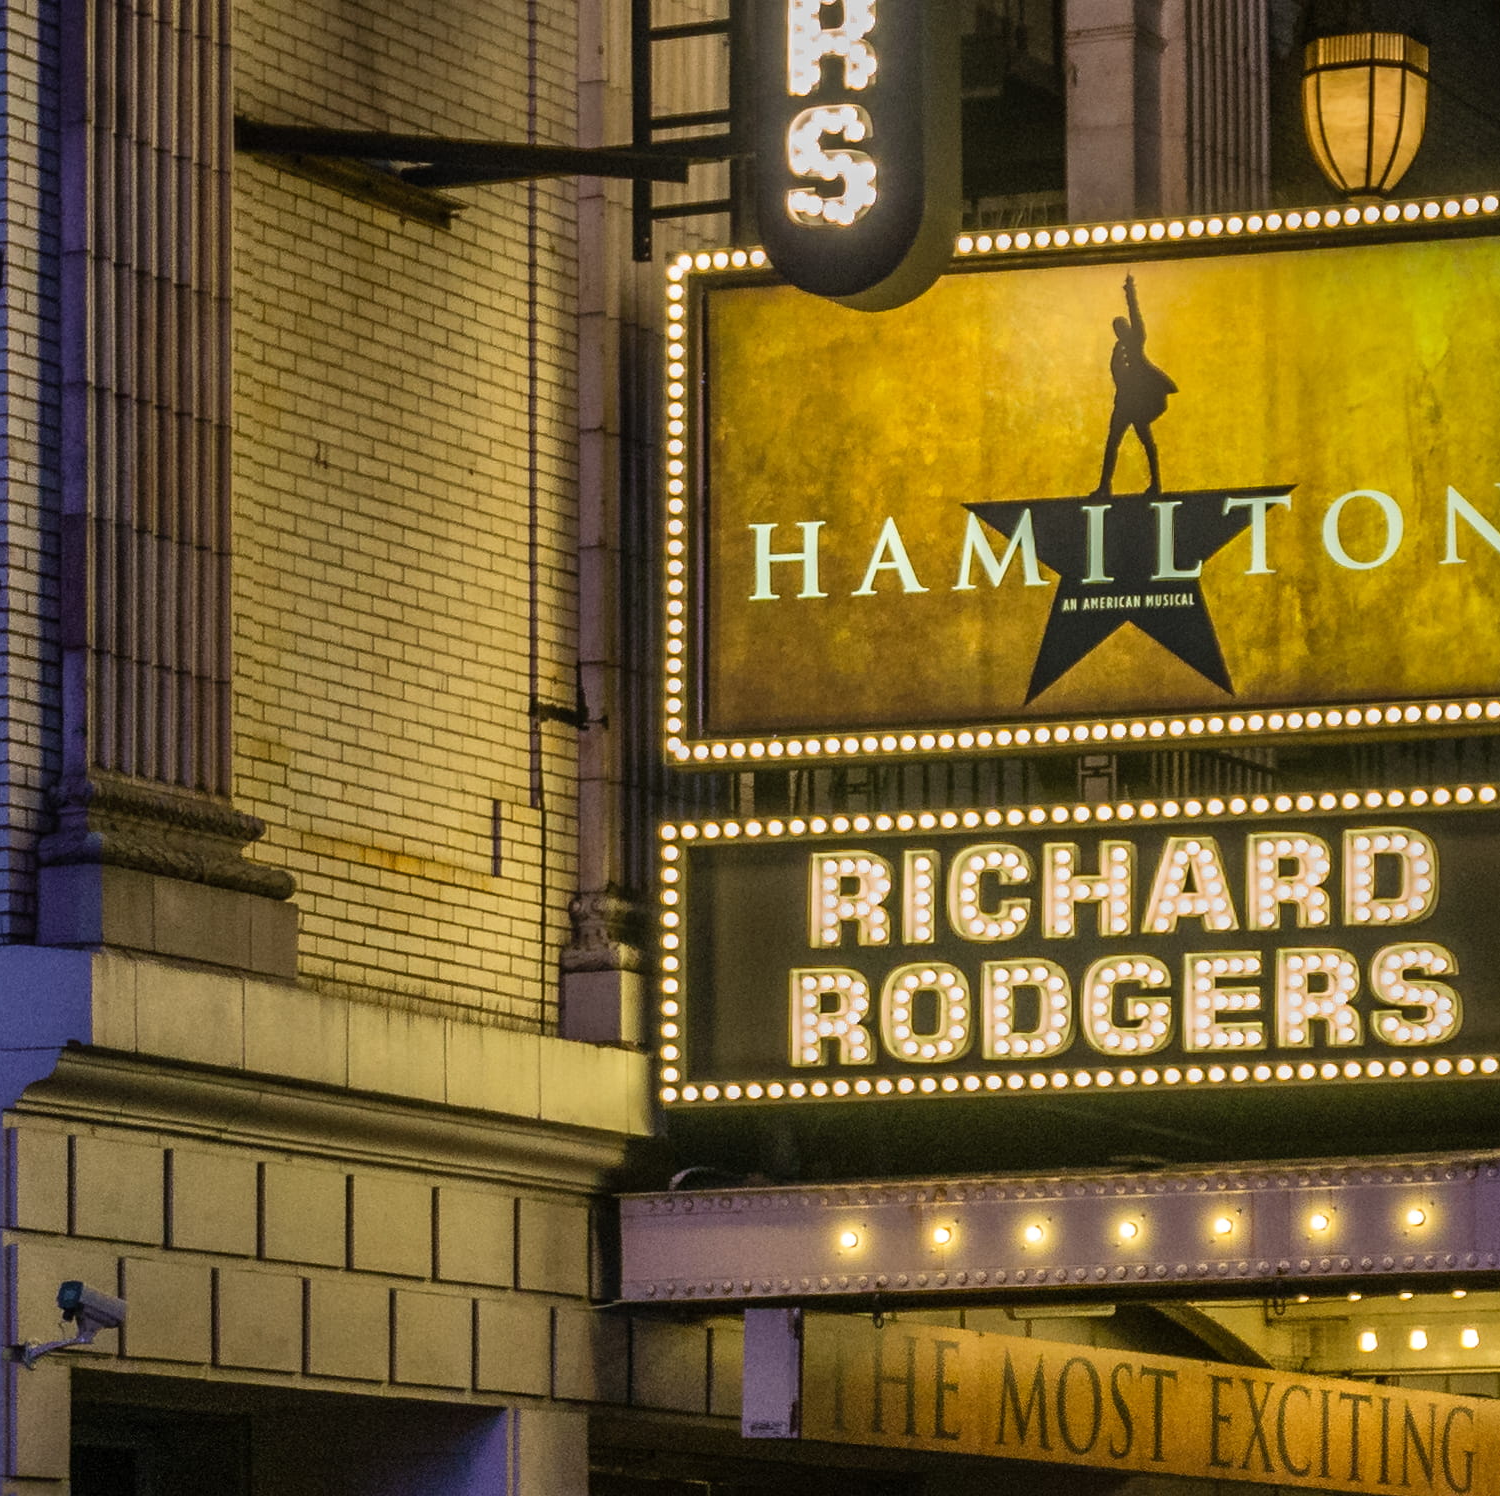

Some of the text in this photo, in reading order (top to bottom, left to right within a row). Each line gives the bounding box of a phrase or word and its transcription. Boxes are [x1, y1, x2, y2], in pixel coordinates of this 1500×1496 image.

[1062, 593, 1195, 612] AN AMERICAN MUSICAL
[807, 825, 1440, 949] RICHARD
[789, 941, 1464, 1068] RODGERS
[994, 1346, 1178, 1462] MOST
[1208, 1374, 1475, 1495] EXCITING
